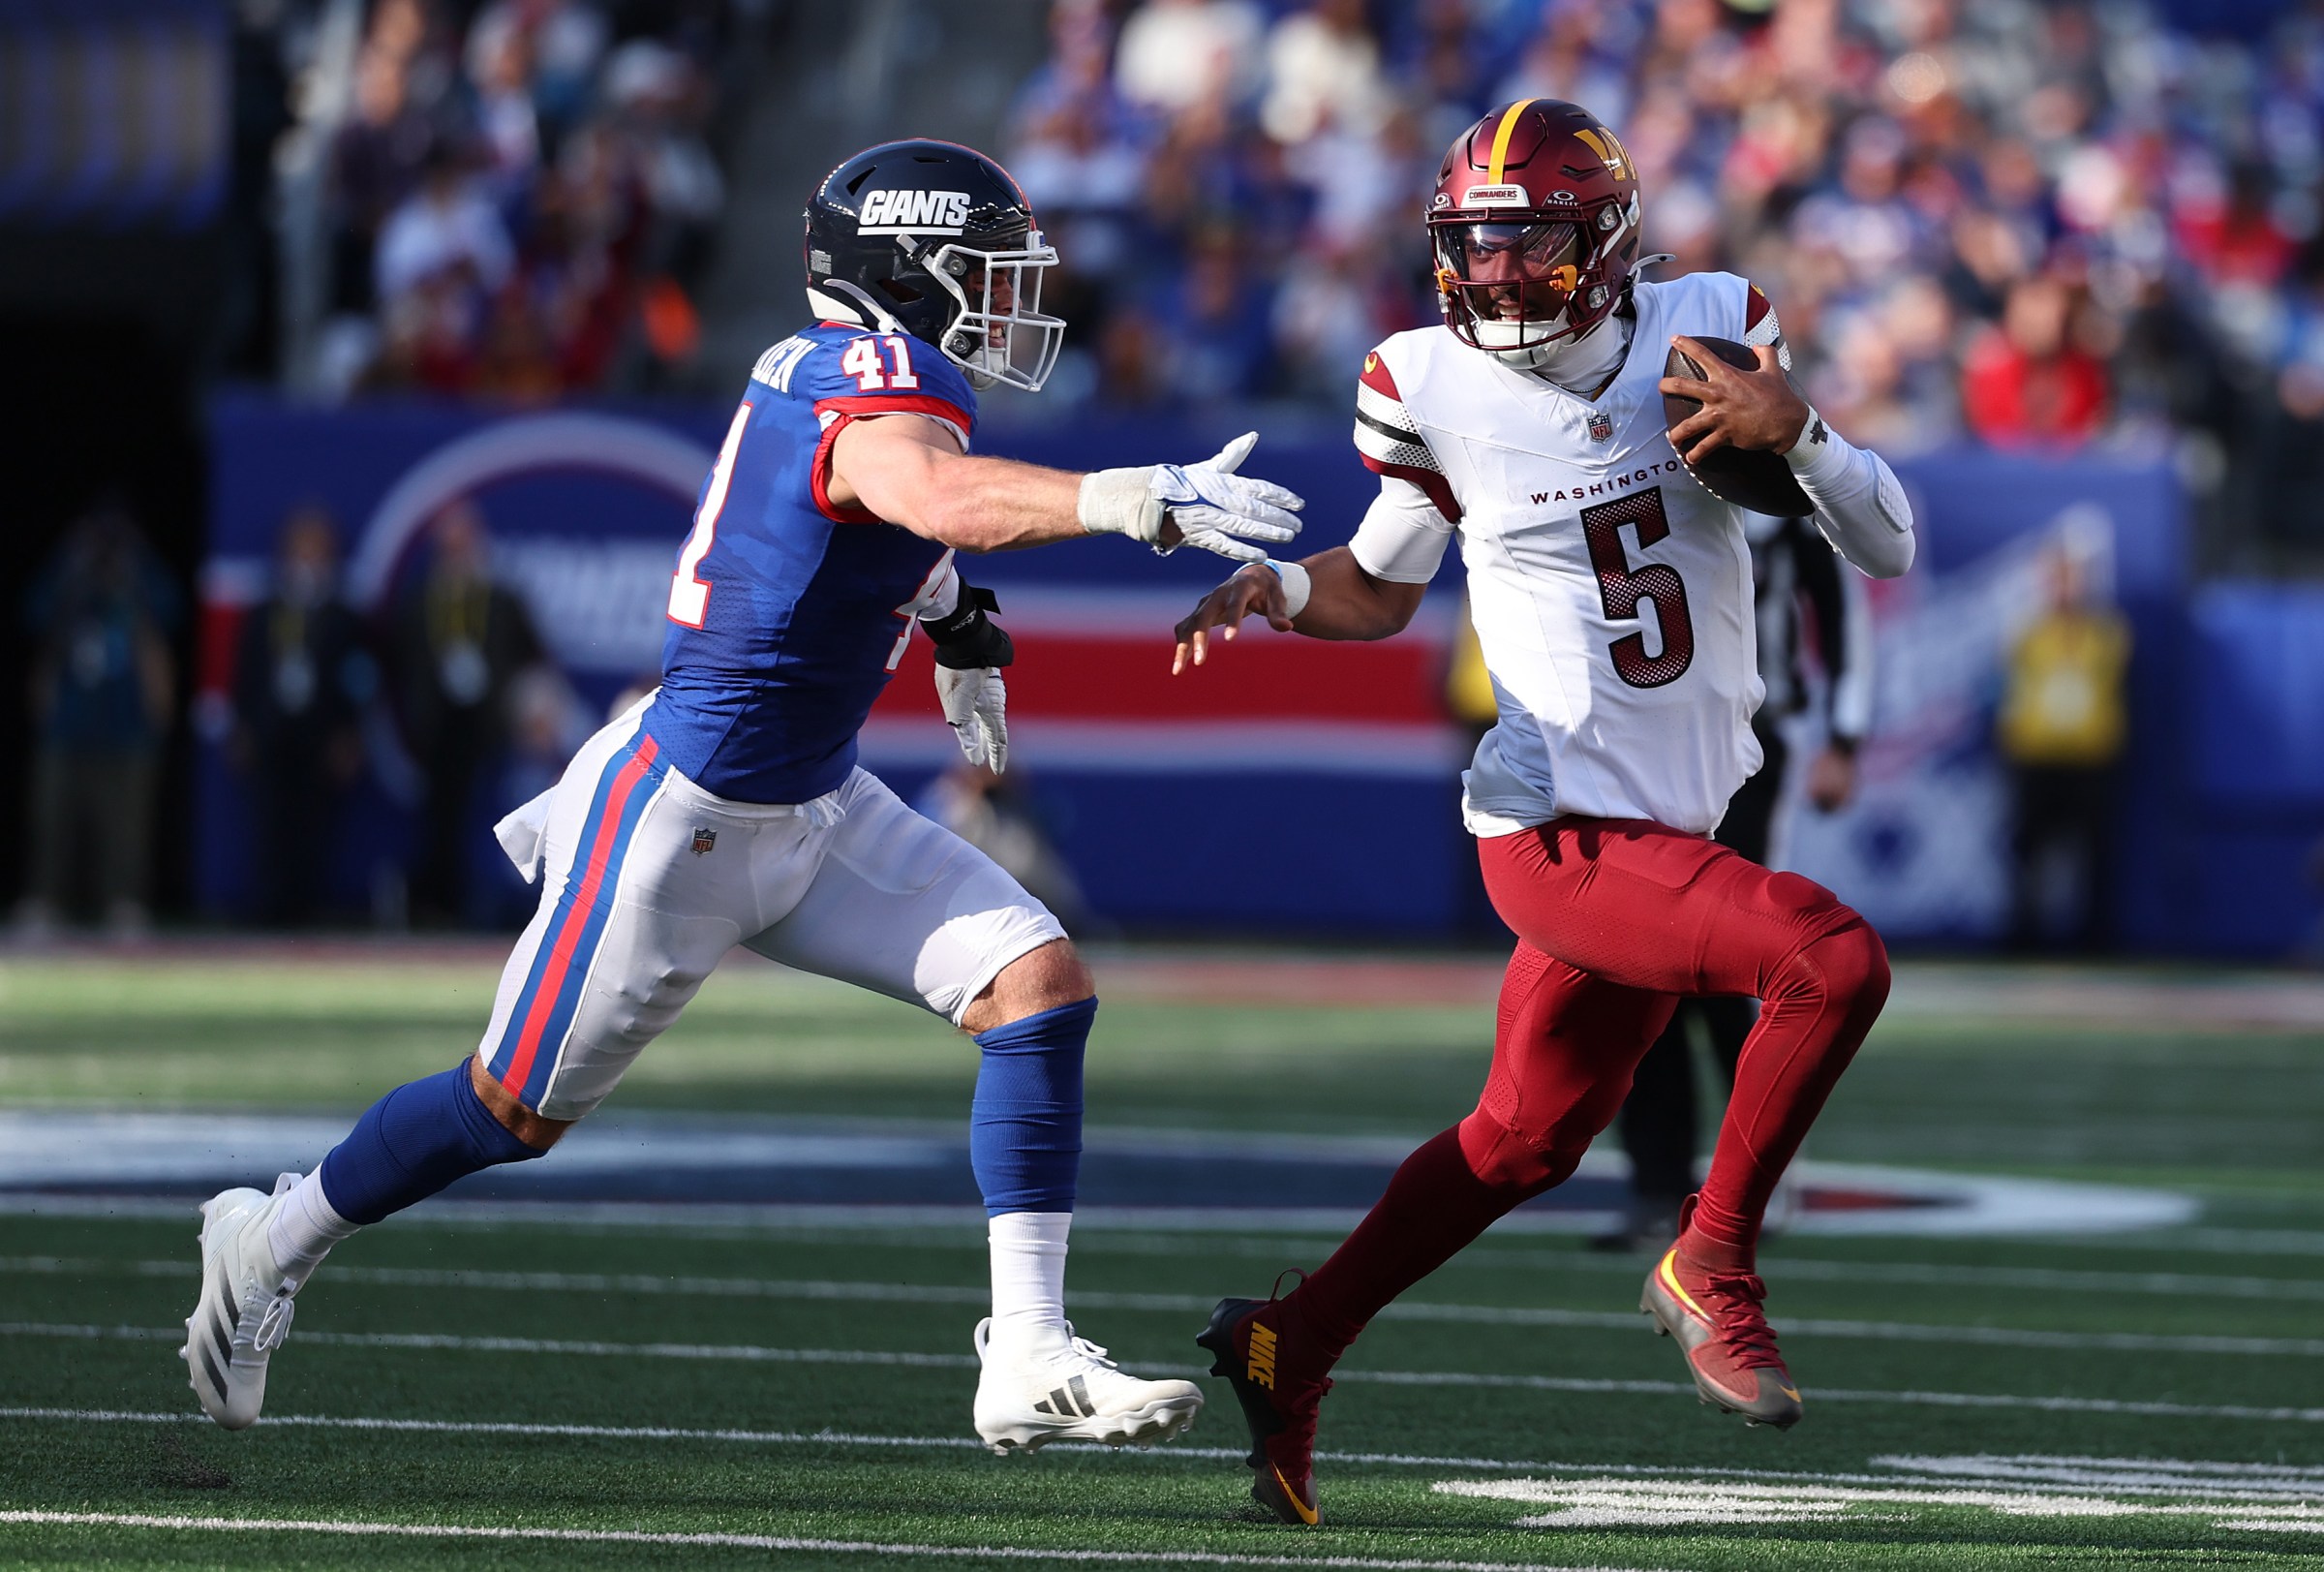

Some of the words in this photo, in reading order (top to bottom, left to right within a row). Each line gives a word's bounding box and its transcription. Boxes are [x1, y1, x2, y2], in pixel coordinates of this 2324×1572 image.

[860, 190, 970, 226] GIANTS
[1468, 190, 1517, 199] COMMANDERS
[1547, 199, 1579, 207] OAKLEY
[840, 335, 920, 391] 41
[1590, 423, 1612, 440] NFL
[1531, 460, 1678, 505] WASHINGTO
[666, 400, 754, 631] 1
[1579, 485, 1695, 689] 5
[1248, 1320, 1277, 1391] NIKE
